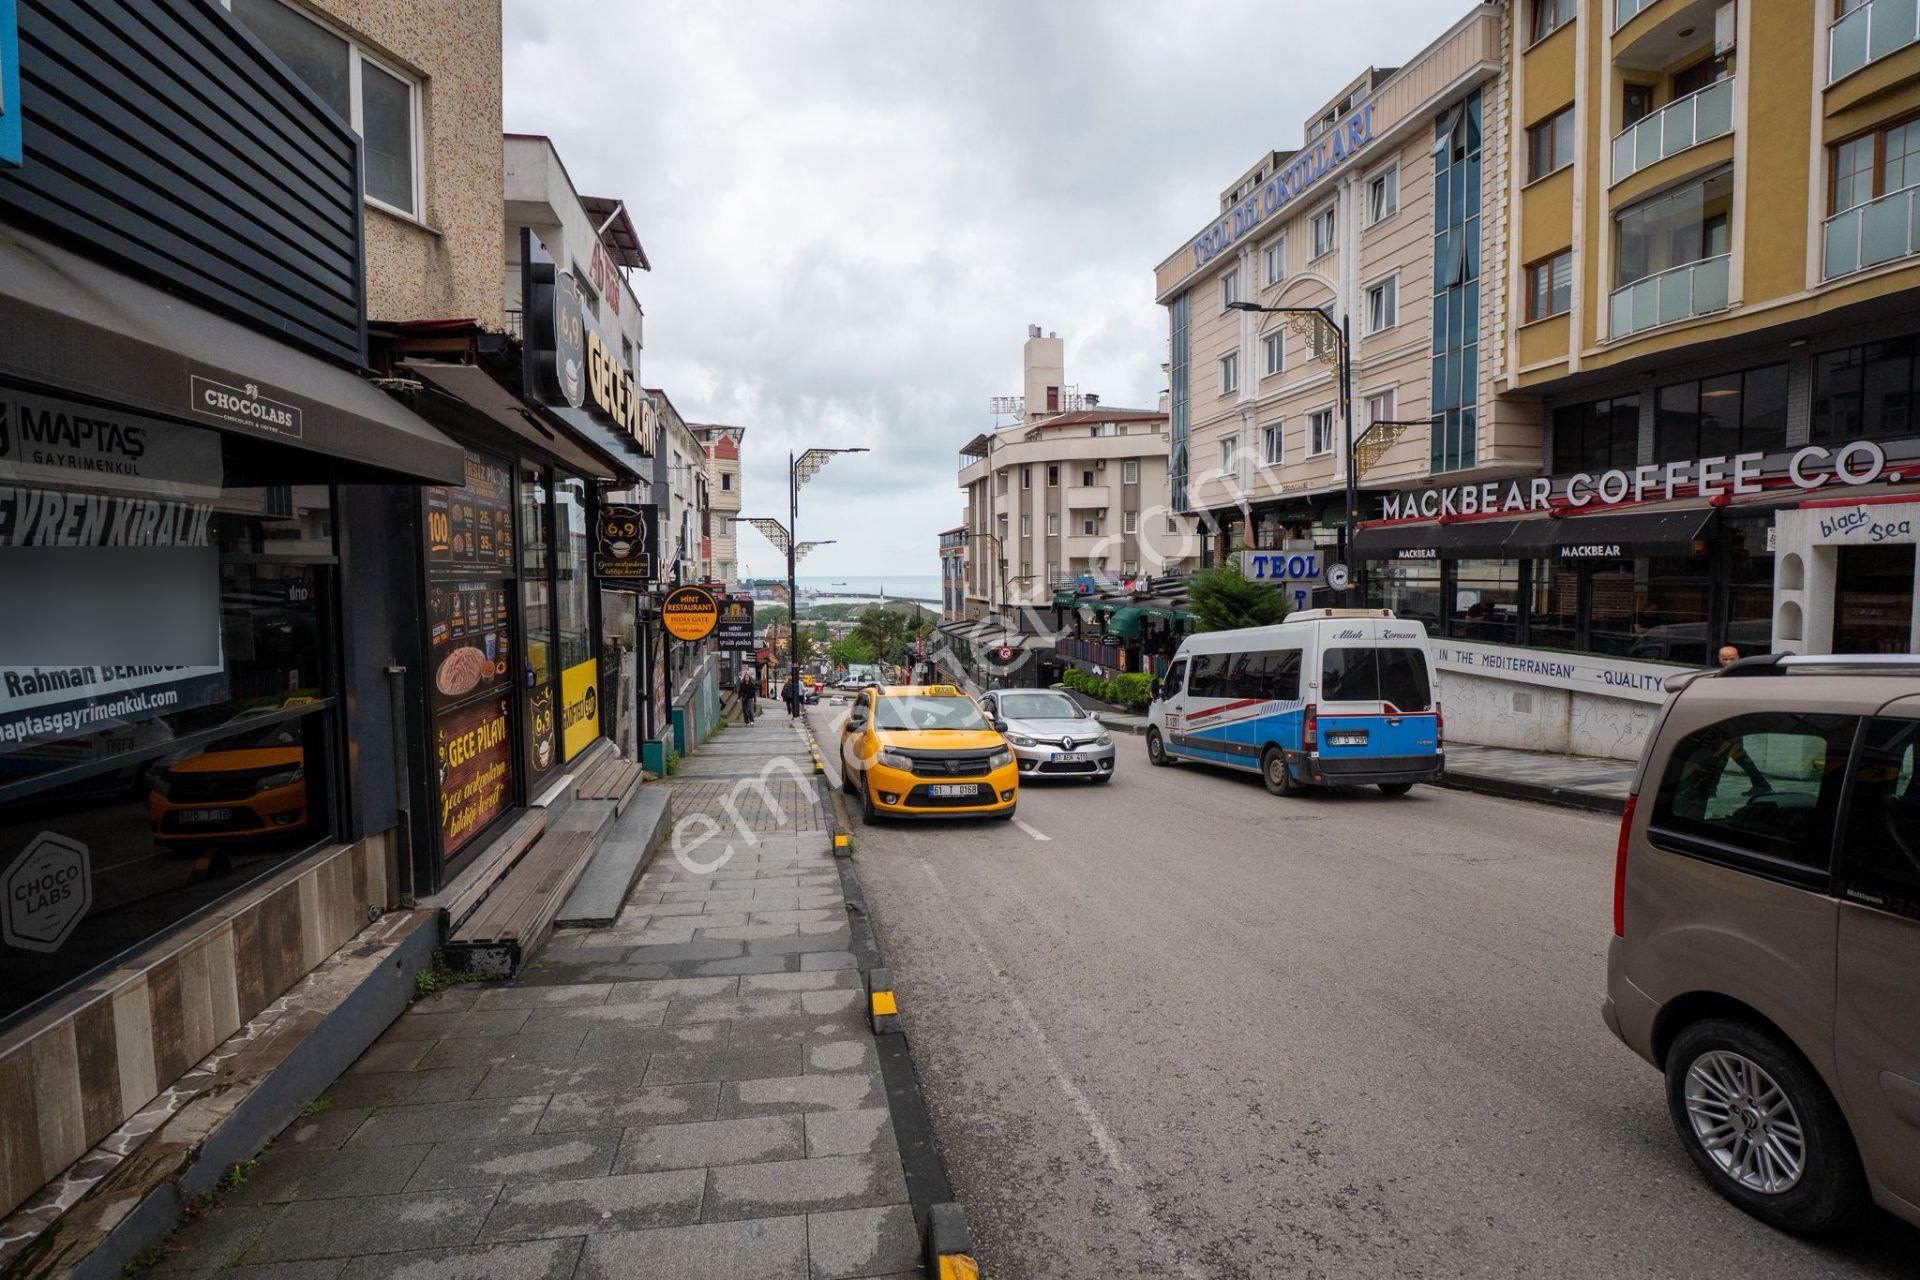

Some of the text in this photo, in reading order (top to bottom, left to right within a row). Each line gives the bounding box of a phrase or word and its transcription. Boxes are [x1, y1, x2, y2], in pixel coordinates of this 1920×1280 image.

[1263, 103, 1375, 216] OKULLARI
[204, 389, 293, 427] CHOCOLABS
[20, 406, 144, 460] MAPTAŞ
[1383, 440, 1900, 521] MACKBEAR COFFEE CO.
[428, 512, 448, 543] 100
[1820, 507, 1911, 542] black sea
[1399, 549, 1436, 559] MACKBEAR
[1561, 545, 1621, 557] MACKBEAR
[1252, 555, 1320, 580] TEOL
[667, 603, 712, 611] RESTAURANT
[680, 594, 699, 603] HİNT
[1439, 648, 1448, 661] IN
[1456, 651, 1473, 665] THE
[4, 666, 97, 698] Rahman
[449, 731, 475, 768] GECE
[477, 716, 506, 753] PİLAVI
[960, 785, 977, 794] 0168
[15, 865, 79, 901] CHOCO
[27, 884, 72, 915] LABS
